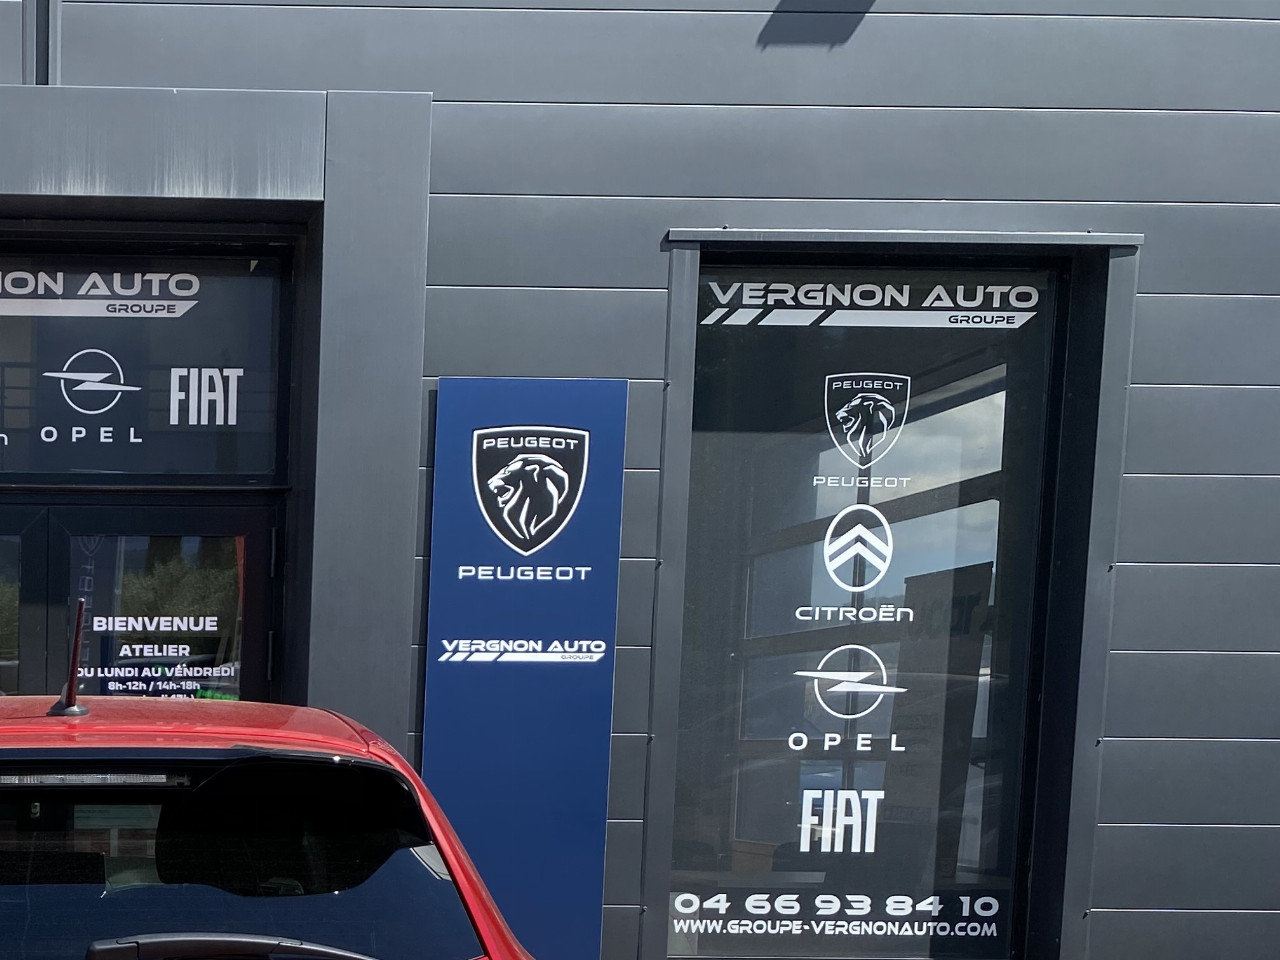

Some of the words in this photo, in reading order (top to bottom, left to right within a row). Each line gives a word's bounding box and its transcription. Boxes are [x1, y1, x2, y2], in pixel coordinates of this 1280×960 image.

[76, 272, 200, 297] AUTO
[708, 281, 910, 307] VERGNON
[920, 284, 1039, 309] AUTO
[105, 303, 177, 314] GROUPE
[948, 314, 1016, 325] GROUPE
[831, 380, 903, 391] PEUGEOT
[169, 367, 244, 426] FIAT
[40, 426, 143, 443] OPEL
[482, 436, 579, 450] PEUGEOT
[812, 475, 911, 488] PEUGEOT
[458, 565, 592, 581] PEUGEOT
[795, 604, 914, 622] CITROËN
[92, 616, 218, 632] BIENVENUE
[118, 644, 191, 657] ATELIER
[441, 639, 543, 652] VERGNON
[546, 640, 607, 653] AUTO
[77, 667, 95, 678] DU
[97, 667, 139, 678] LUNDI
[141, 667, 162, 678] AU
[164, 667, 235, 678] VENDREDI
[107, 681, 147, 691] 8h-12h
[148, 681, 155, 692] /
[156, 680, 201, 691] 14h-18h
[788, 732, 906, 752] OPEL
[798, 789, 885, 853] FIAT
[674, 893, 732, 915] 04
[744, 893, 801, 915] 66
[814, 894, 872, 916] 93
[885, 895, 944, 917] 84
[958, 896, 1000, 917] 10
[673, 918, 997, 937] WWW.GROUPE-VERGNONAUTO.COM
